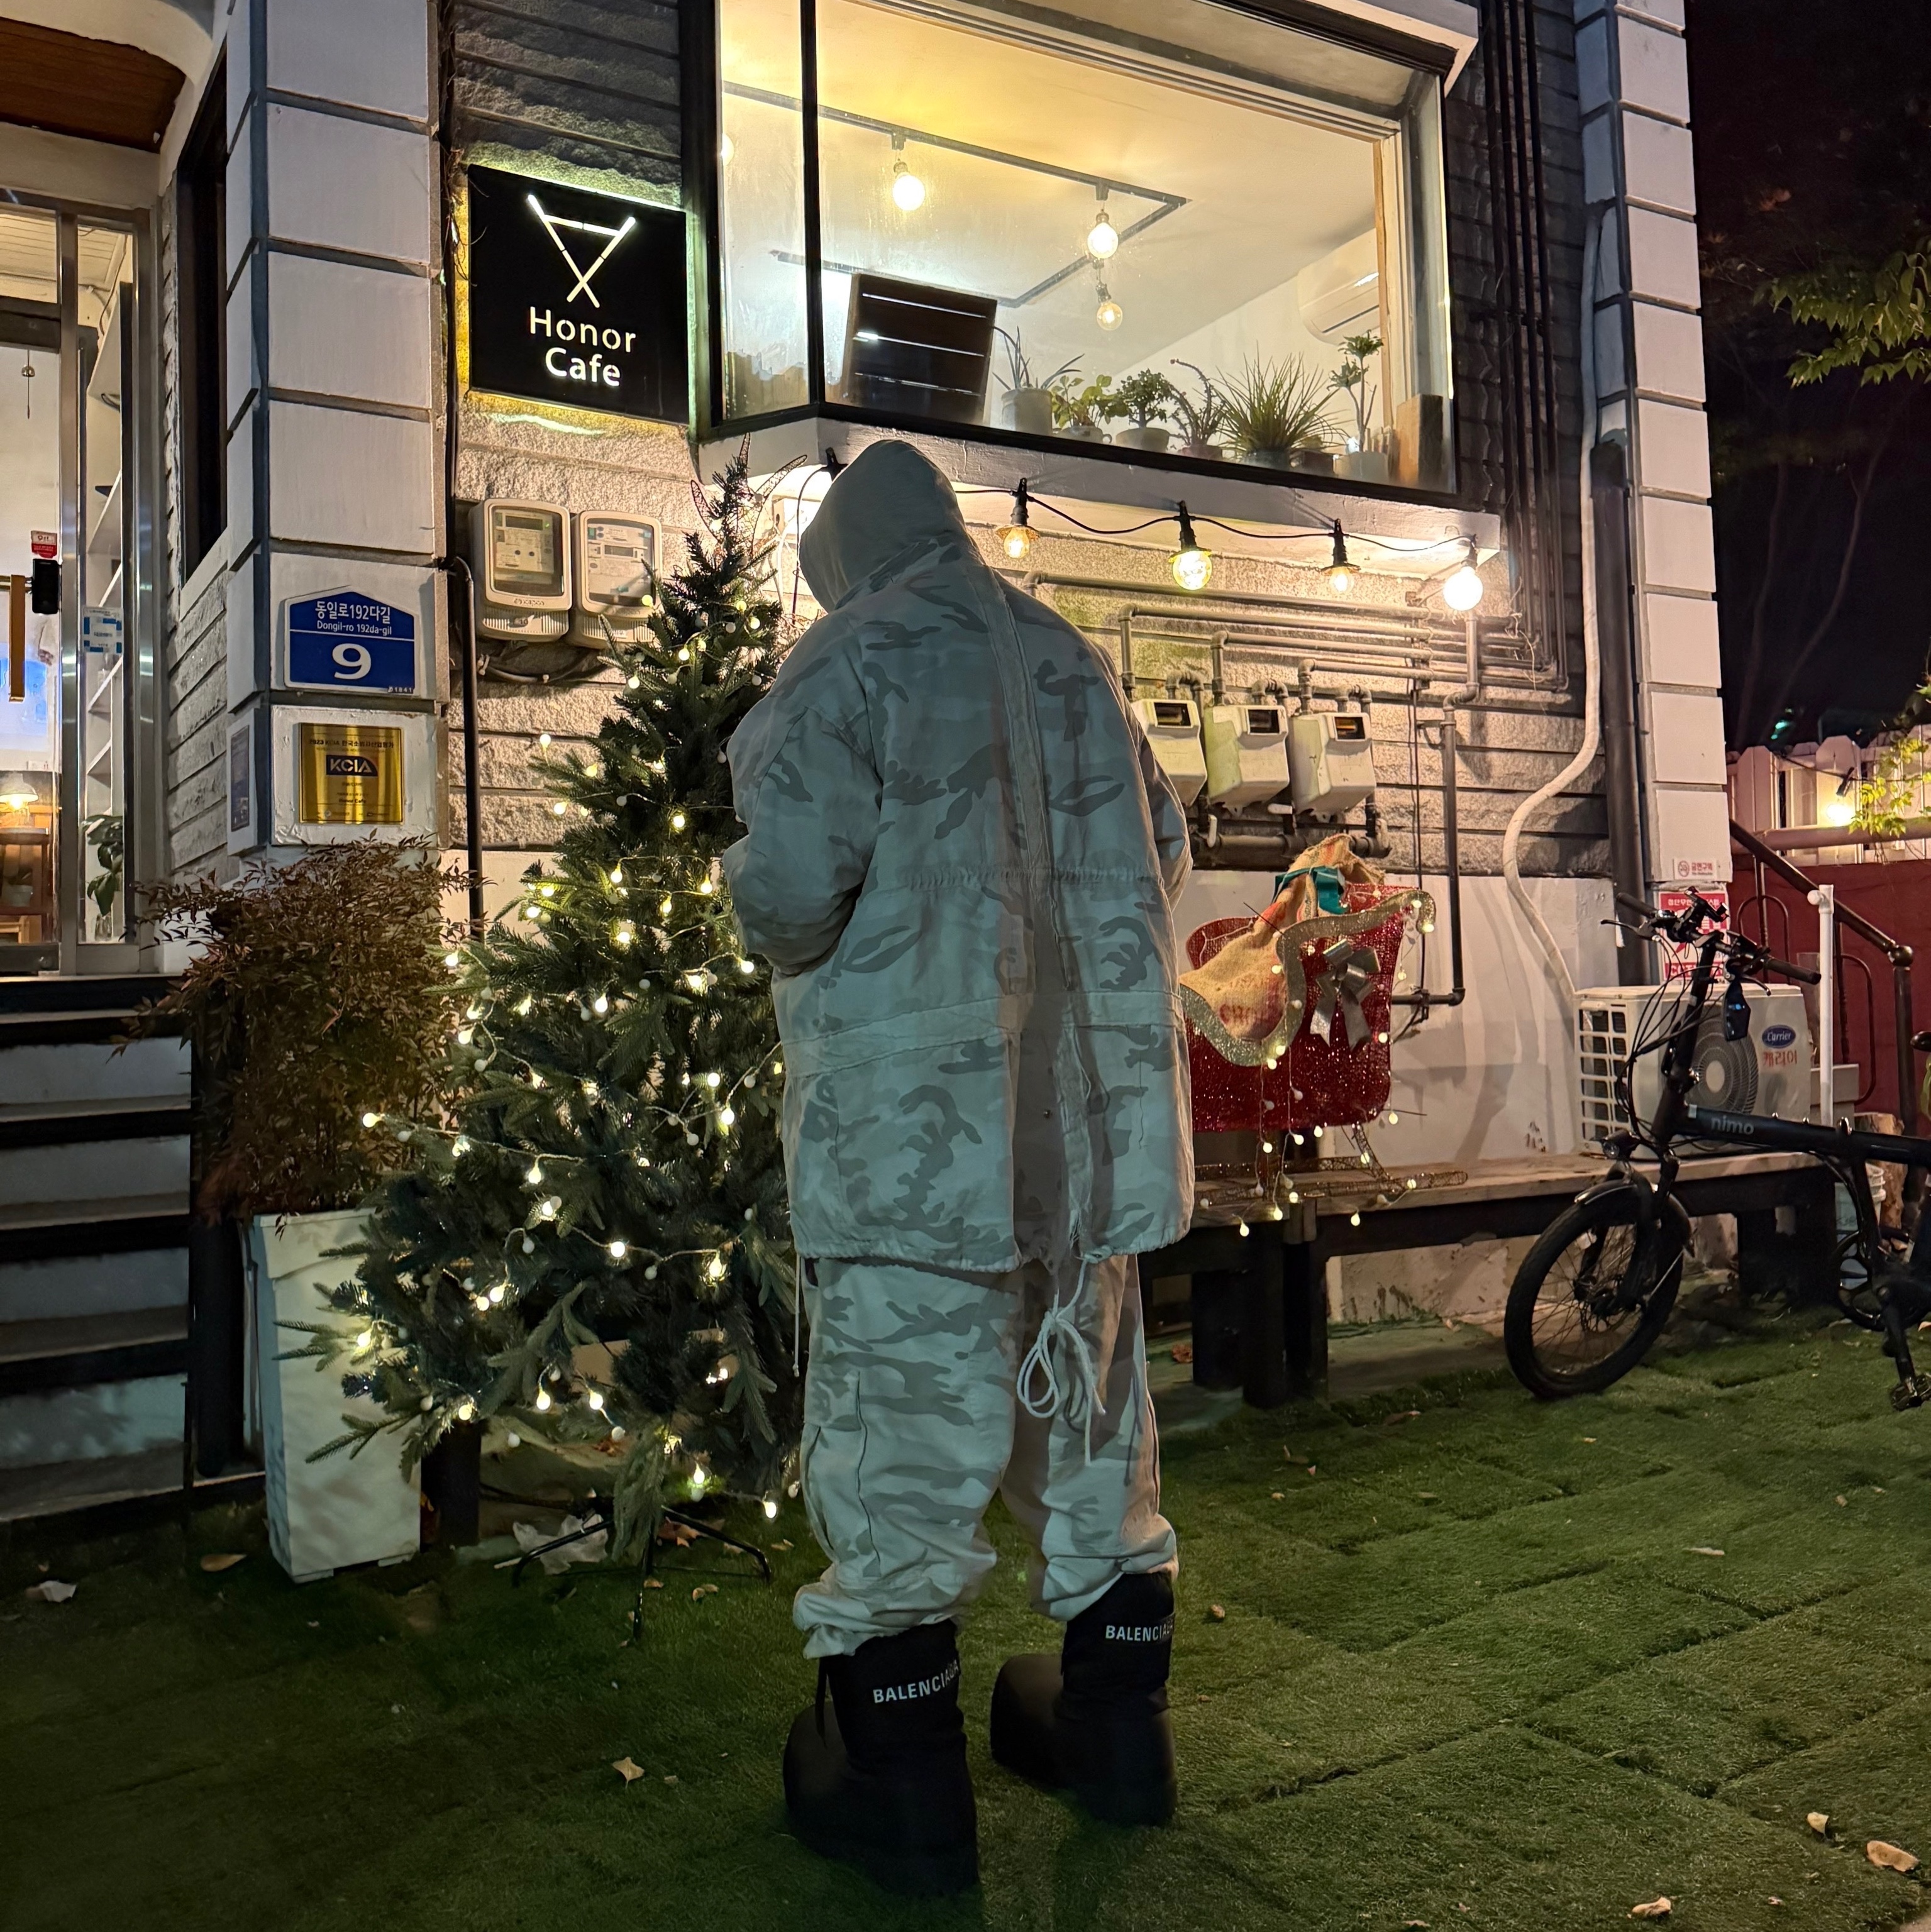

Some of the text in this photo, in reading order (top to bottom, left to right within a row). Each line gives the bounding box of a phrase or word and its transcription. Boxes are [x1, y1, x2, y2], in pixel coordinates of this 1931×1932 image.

[530, 306, 636, 353] Honor
[545, 347, 621, 387] Cafe
[315, 601, 390, 624] 동일로192다길
[317, 620, 392, 636] Dongil-ro 192da-gil
[332, 643, 371, 680] 9
[330, 758, 372, 773] KCIA
[1767, 1030, 1792, 1042] Carrier
[1711, 1115, 1754, 1135] nimo
